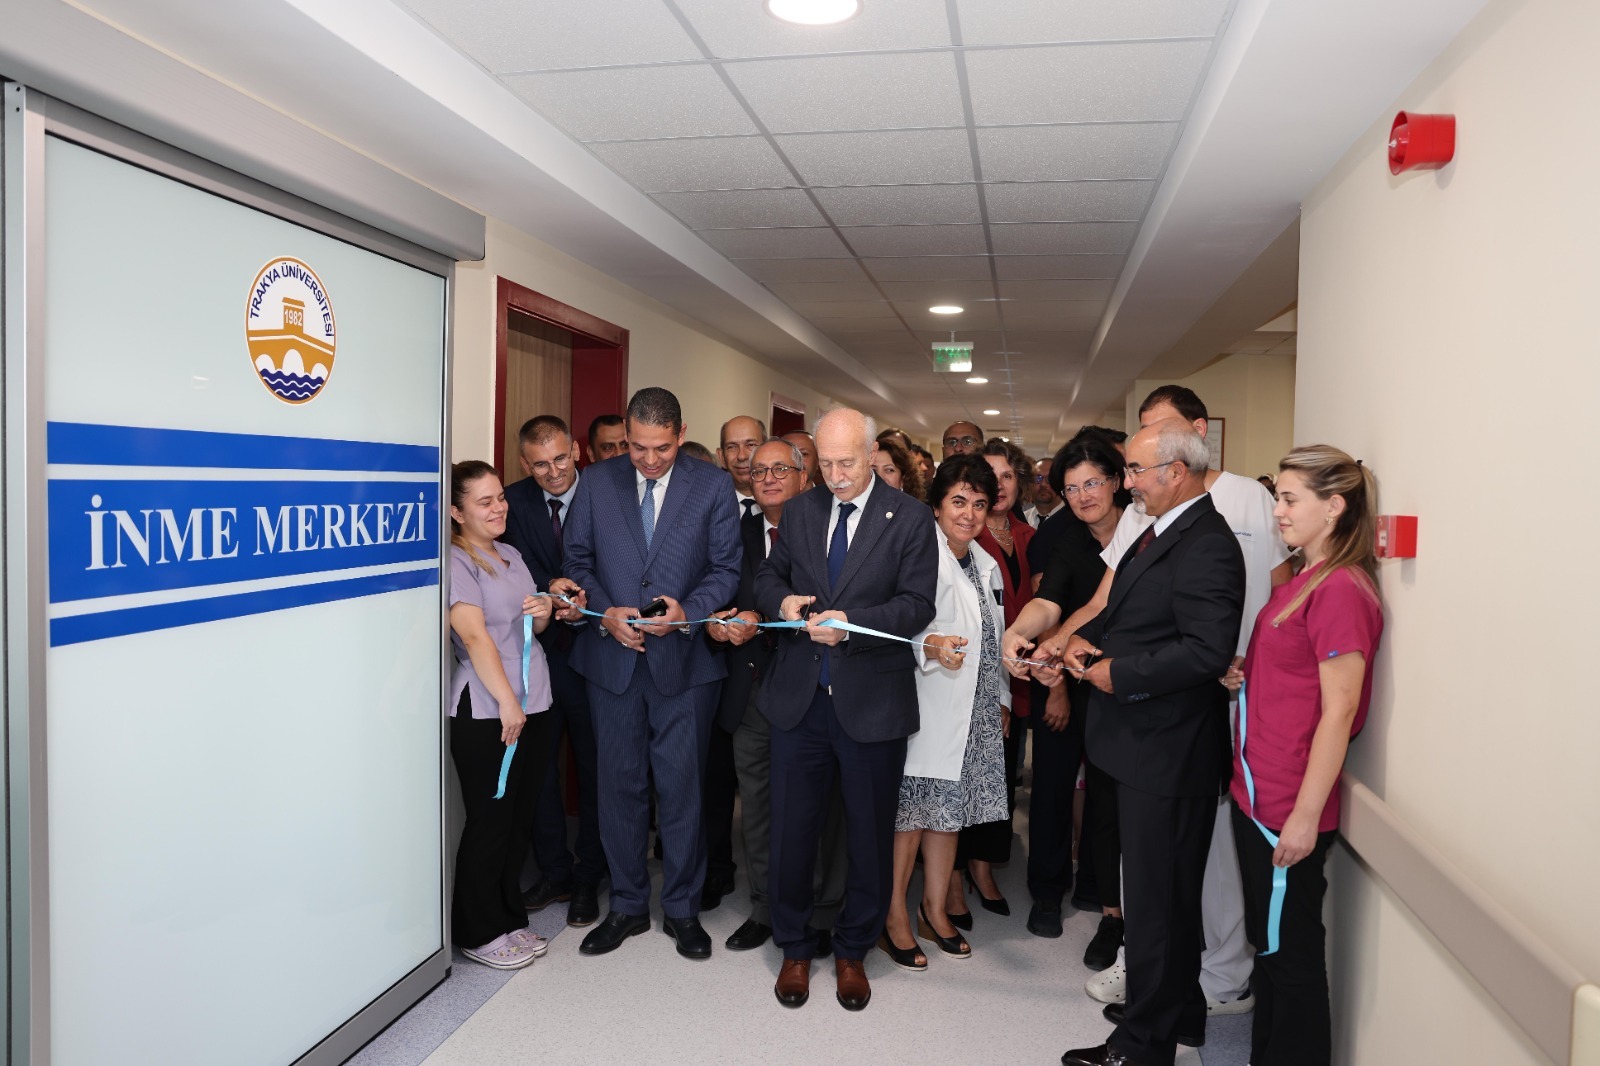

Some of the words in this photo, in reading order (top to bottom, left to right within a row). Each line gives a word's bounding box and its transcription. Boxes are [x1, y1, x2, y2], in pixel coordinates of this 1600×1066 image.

[250, 268, 281, 319] TRAKYA
[281, 262, 335, 337] ÜNİVERSİTESİ
[284, 308, 303, 327] 1982
[85, 494, 239, 571] İNME
[252, 491, 427, 556] MERKEZİ
